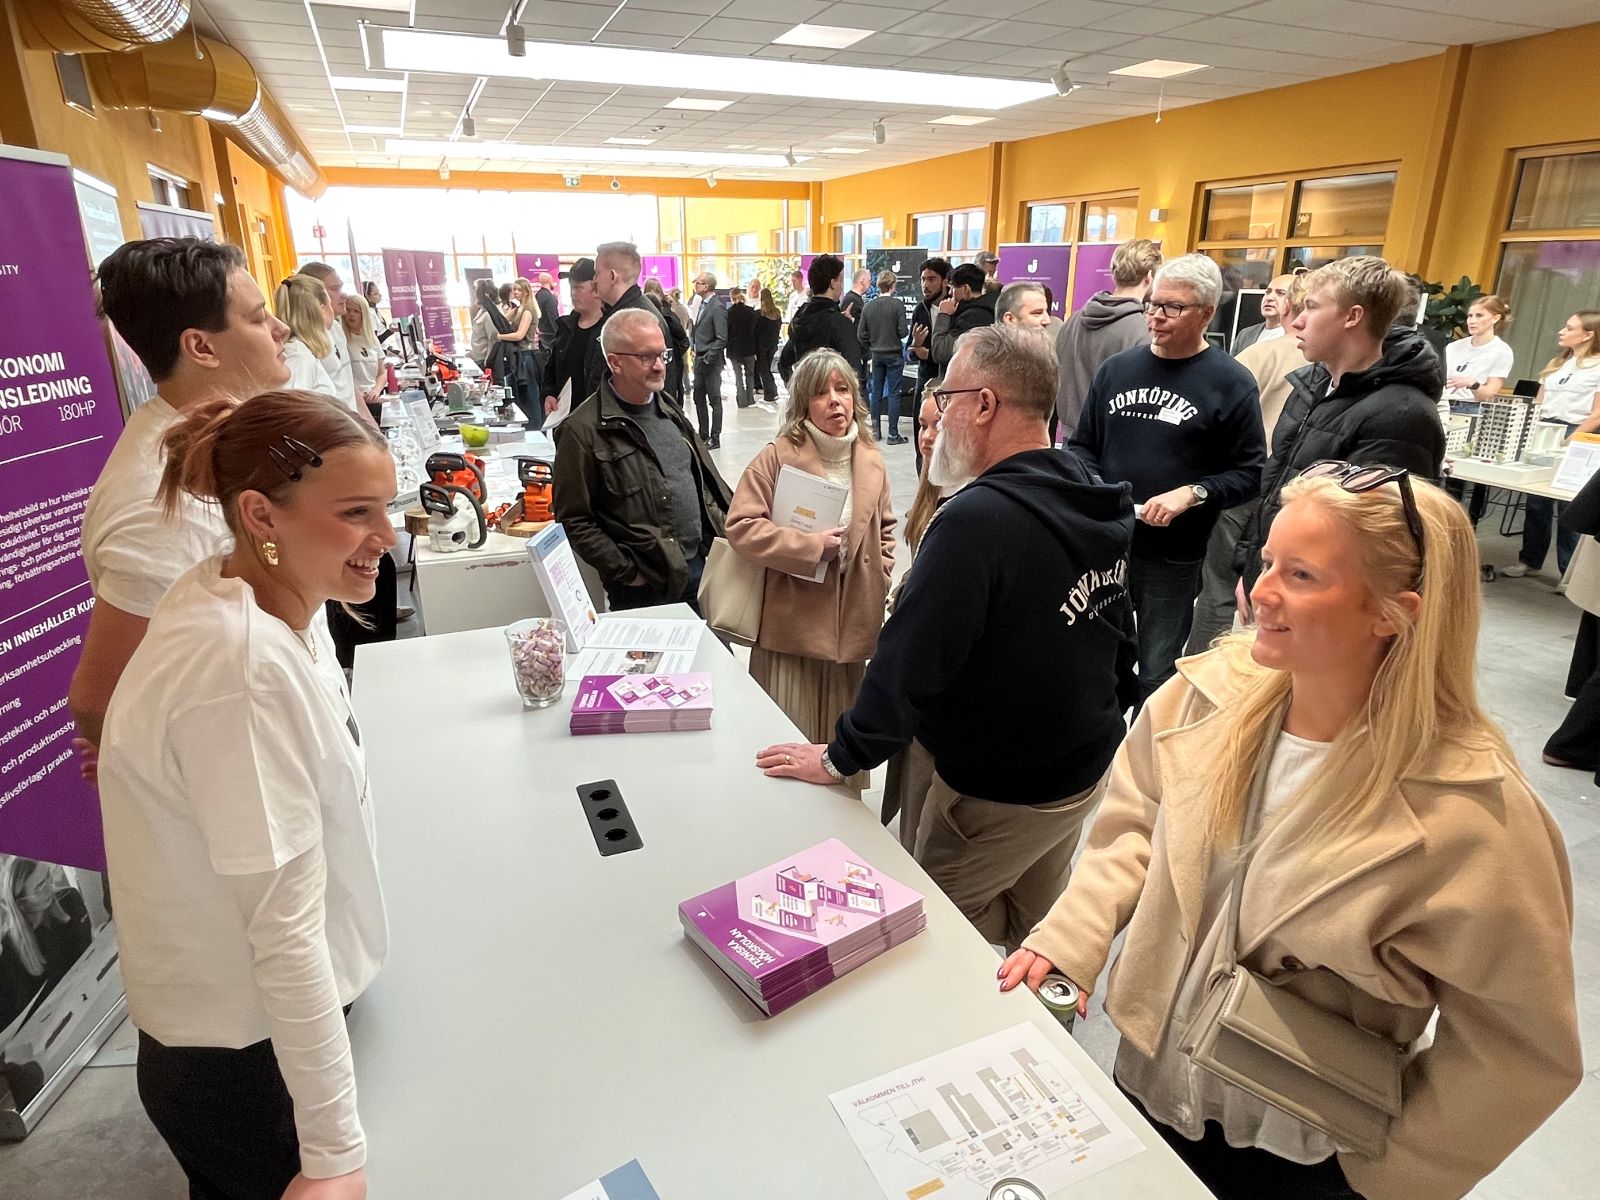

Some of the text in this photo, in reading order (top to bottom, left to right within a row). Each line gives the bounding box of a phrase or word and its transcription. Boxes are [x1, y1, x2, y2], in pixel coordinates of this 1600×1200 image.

[58, 400, 96, 422] 180HP
[1108, 386, 1199, 421] JÖNKÖPING
[40, 501, 48, 510] av
[48, 496, 61, 506] hur
[61, 487, 88, 502] tekniska
[53, 501, 83, 517] varandra
[53, 531, 65, 542] dig
[64, 526, 80, 538] som
[21, 555, 35, 568] och
[13, 607, 77, 647] INNEHÅLLER
[33, 708, 49, 723] och
[49, 696, 69, 714] auto
[1, 757, 18, 774] och
[47, 748, 74, 773] praktik
[727, 939, 764, 969] TEKNISKA
[729, 927, 776, 964] HÖGSKOLAN
[895, 1082, 911, 1092] TILL
